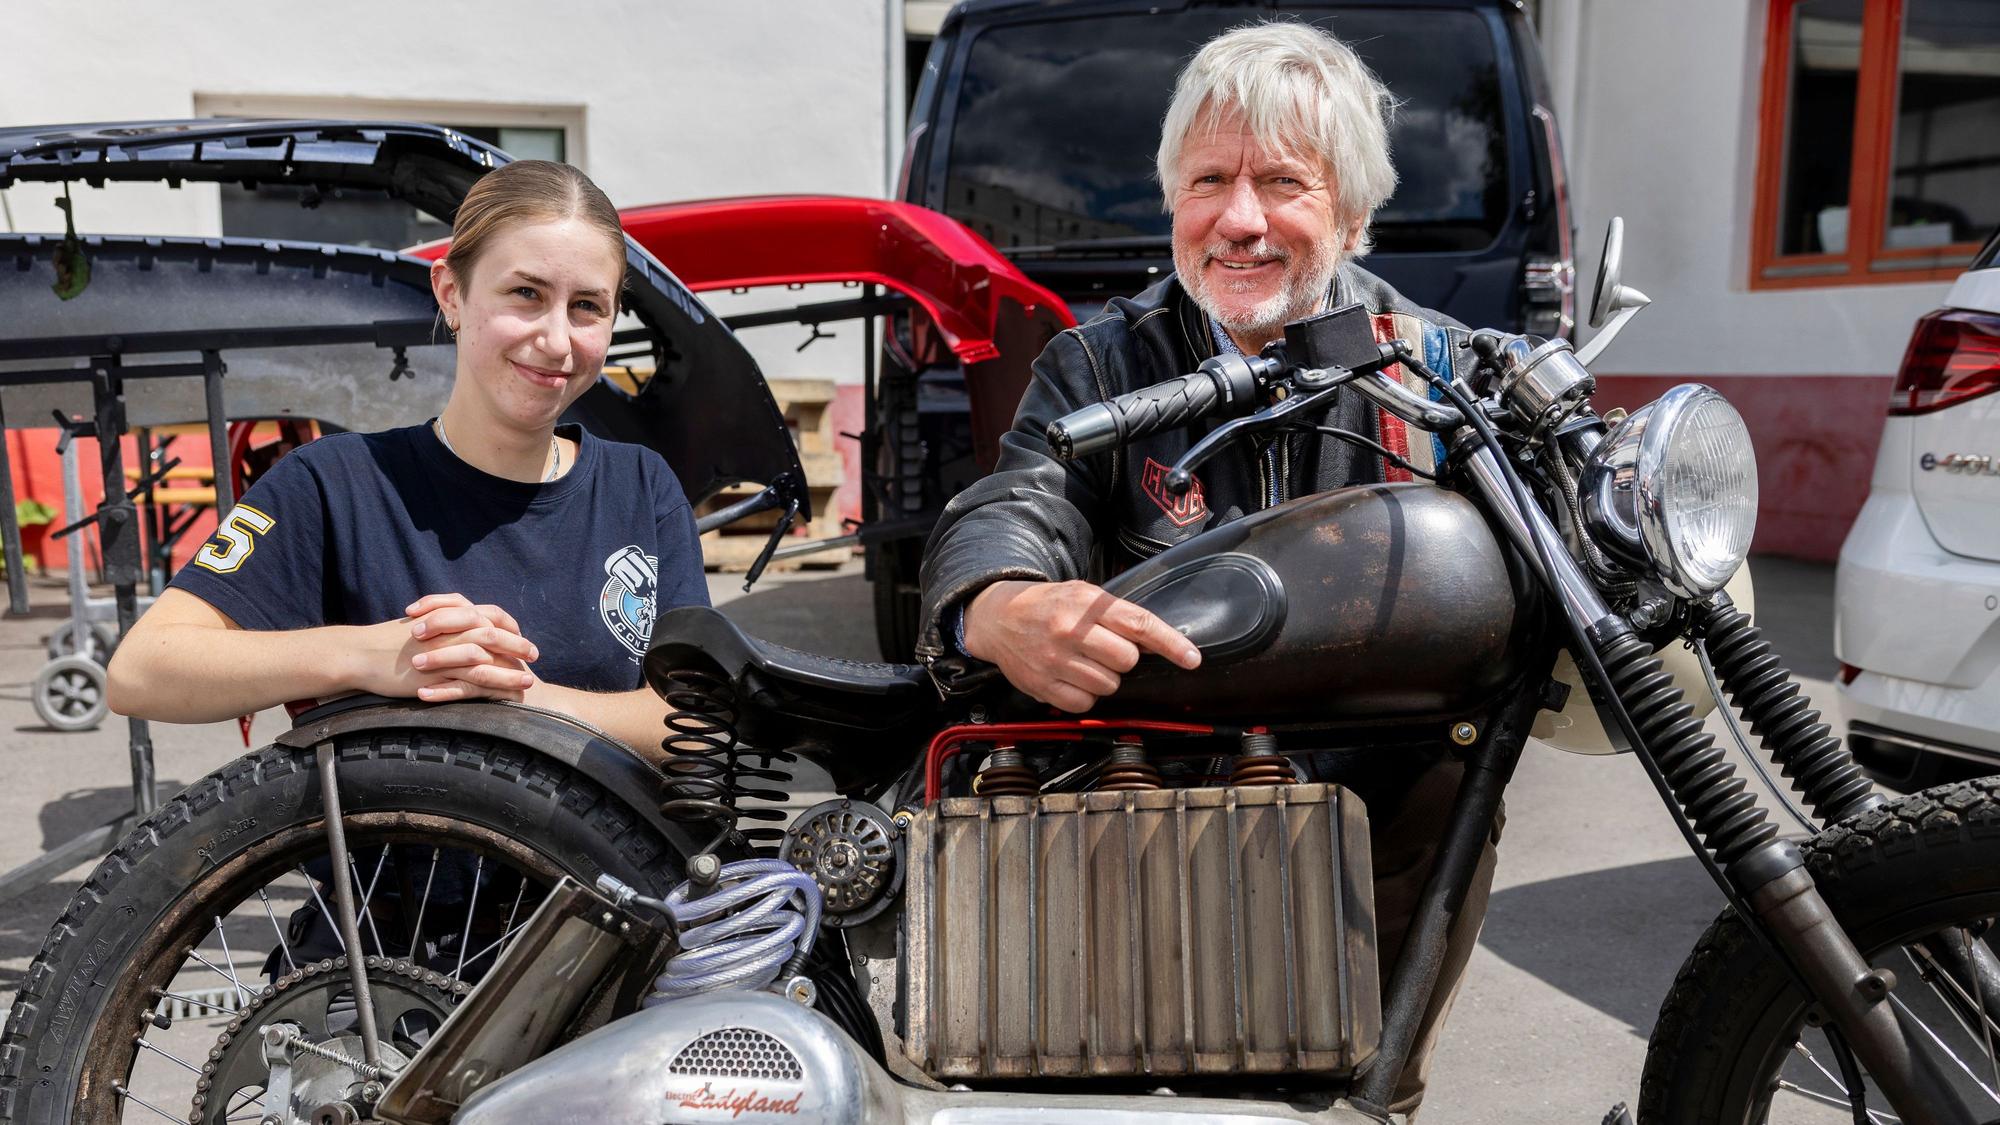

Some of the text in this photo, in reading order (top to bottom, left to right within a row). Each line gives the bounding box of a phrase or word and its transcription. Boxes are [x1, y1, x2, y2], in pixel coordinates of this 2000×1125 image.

[1920, 452, 2000, 477] e-GOL
[194, 503, 276, 574] 5
[615, 622, 650, 650] CONS
[665, 1087, 804, 1119] Electric Ladyland
